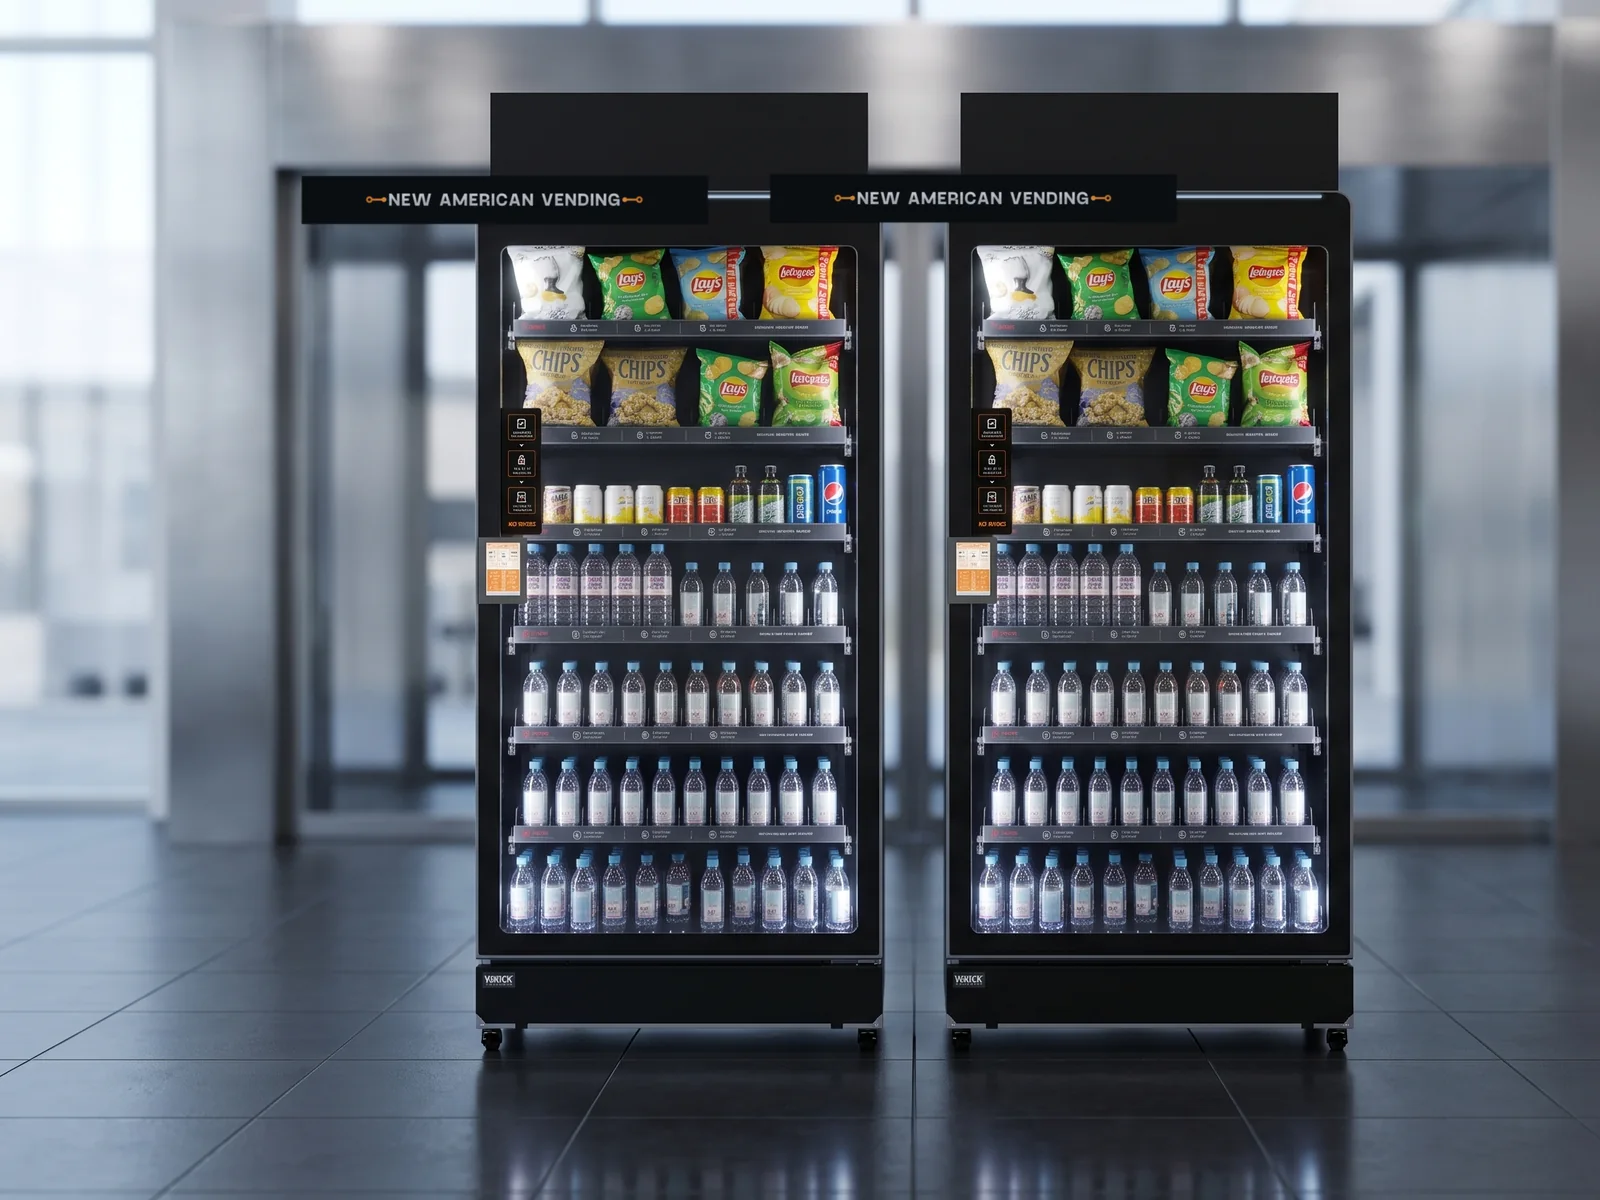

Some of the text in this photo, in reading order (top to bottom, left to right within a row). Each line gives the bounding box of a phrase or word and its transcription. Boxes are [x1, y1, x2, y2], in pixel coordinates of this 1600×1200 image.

[388, 193, 621, 207] NEW AMERICAN VENDING
[856, 191, 1089, 205] NEW AMERICAN VENDING
[532, 350, 582, 373] CHIPS
[618, 358, 667, 381] CHIPS
[1002, 350, 1052, 373] CHIPS
[1087, 358, 1136, 381] CHIPS
